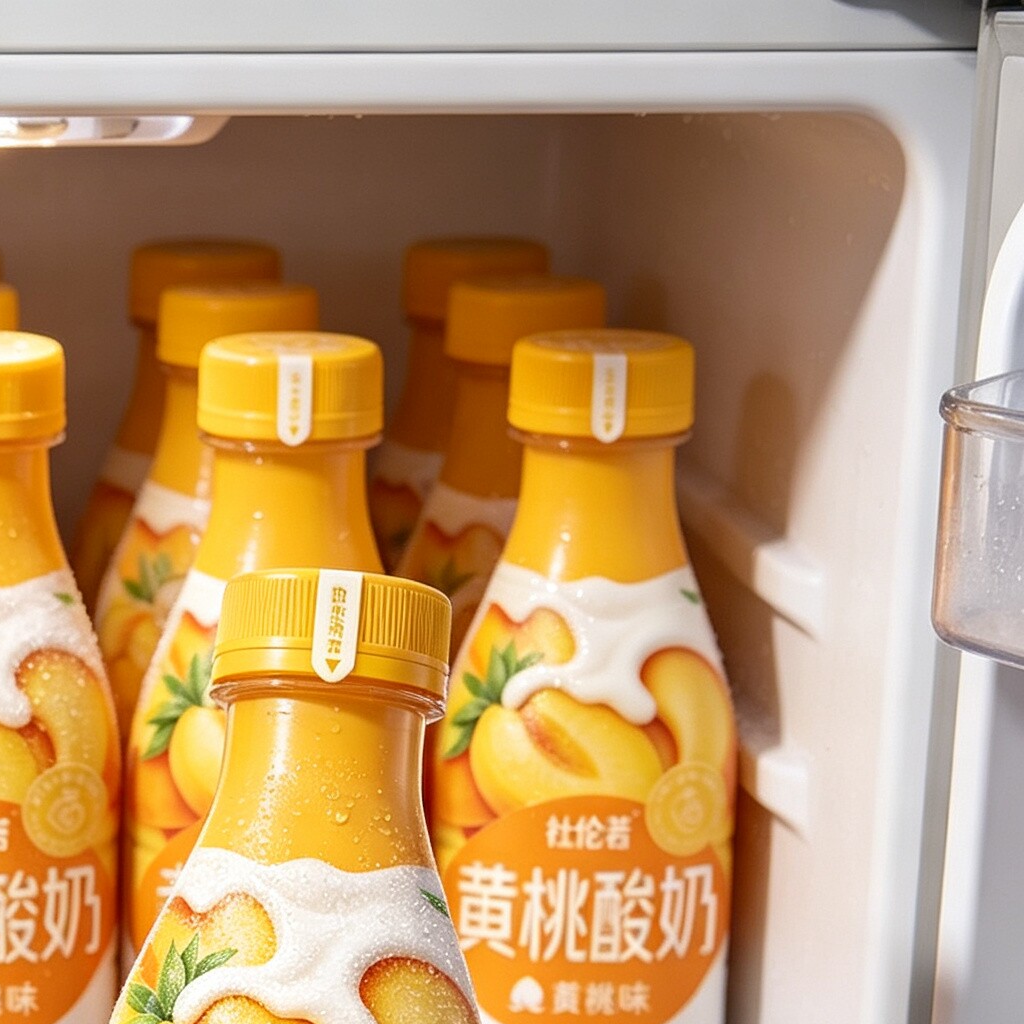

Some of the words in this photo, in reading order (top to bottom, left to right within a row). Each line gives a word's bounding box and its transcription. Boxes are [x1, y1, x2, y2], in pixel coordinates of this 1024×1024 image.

[546, 814, 632, 851] 杜伦若
[457, 861, 718, 964] 黄桃酸奶
[551, 979, 652, 1016] 黄桃味
